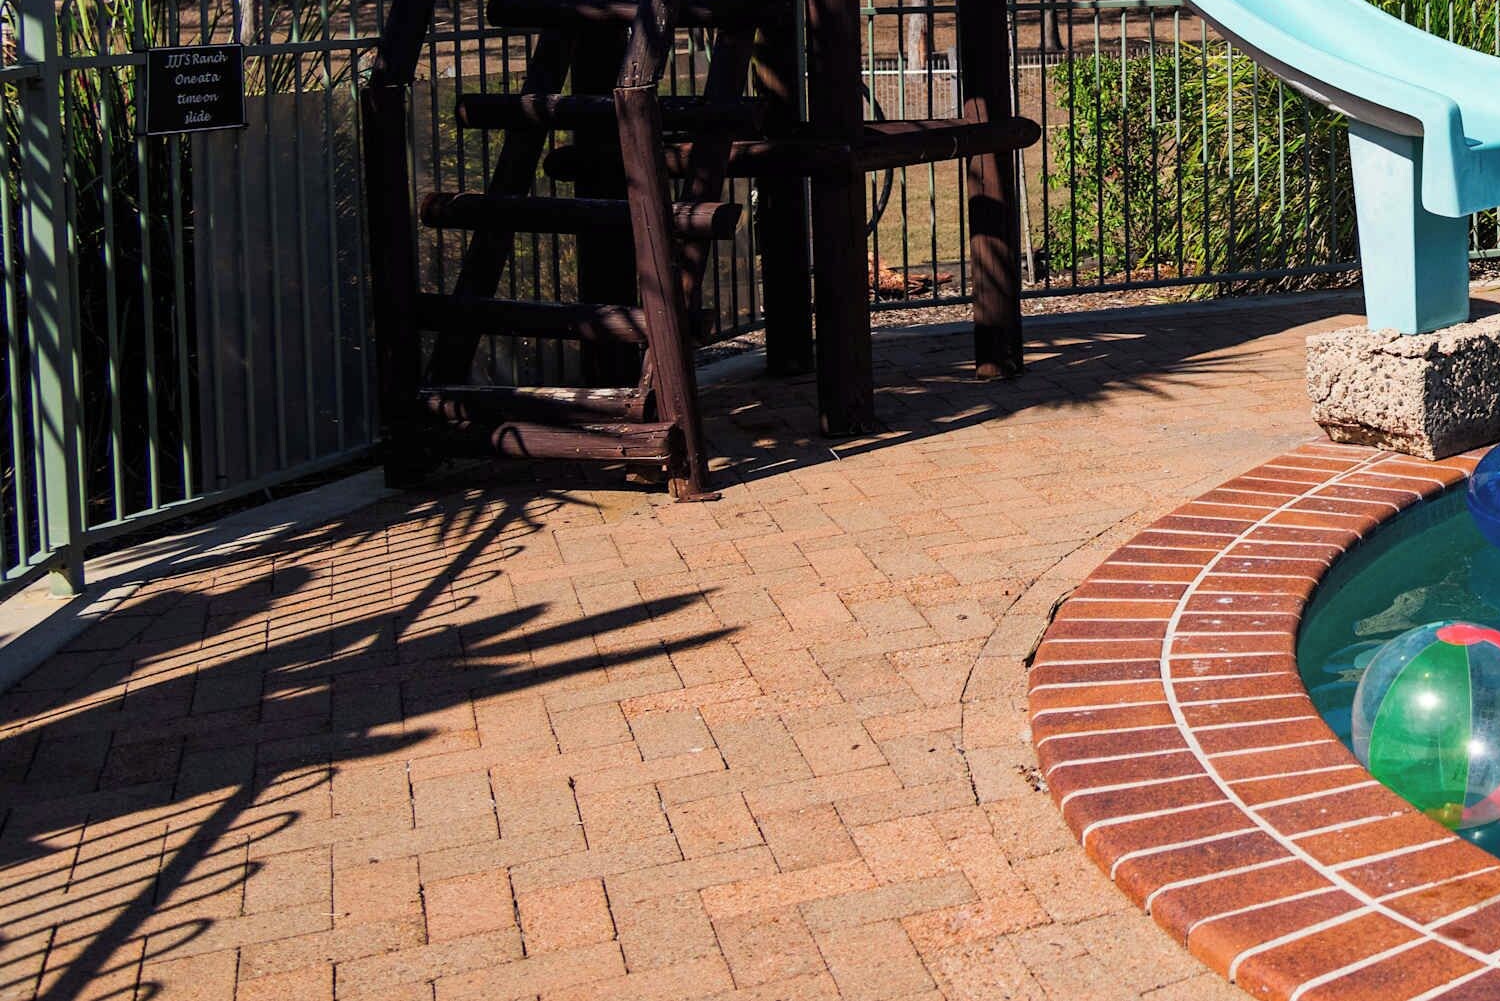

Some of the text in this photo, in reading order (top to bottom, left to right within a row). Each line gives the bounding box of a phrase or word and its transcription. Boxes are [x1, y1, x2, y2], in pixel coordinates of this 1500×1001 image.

[192, 51, 227, 64] Ranch
[175, 73, 221, 85] One at a
[177, 93, 218, 104] time on
[184, 110, 211, 124] slide
